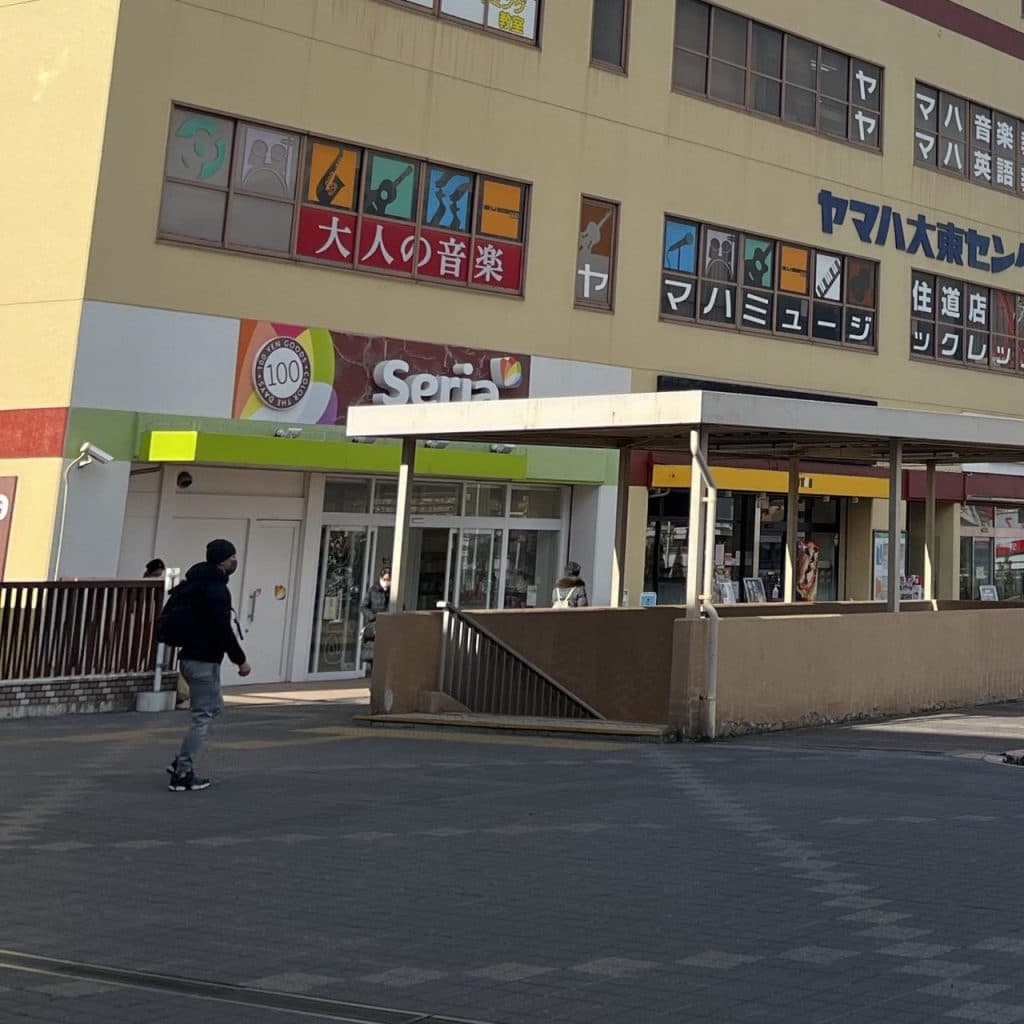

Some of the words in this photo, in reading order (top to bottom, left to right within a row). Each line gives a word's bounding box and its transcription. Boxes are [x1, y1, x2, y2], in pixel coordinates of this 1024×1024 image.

[314, 216, 505, 282] 大人の音楽
[911, 279, 988, 325] 住道店
[266, 359, 301, 387] 100
[372, 359, 500, 406] Seria
